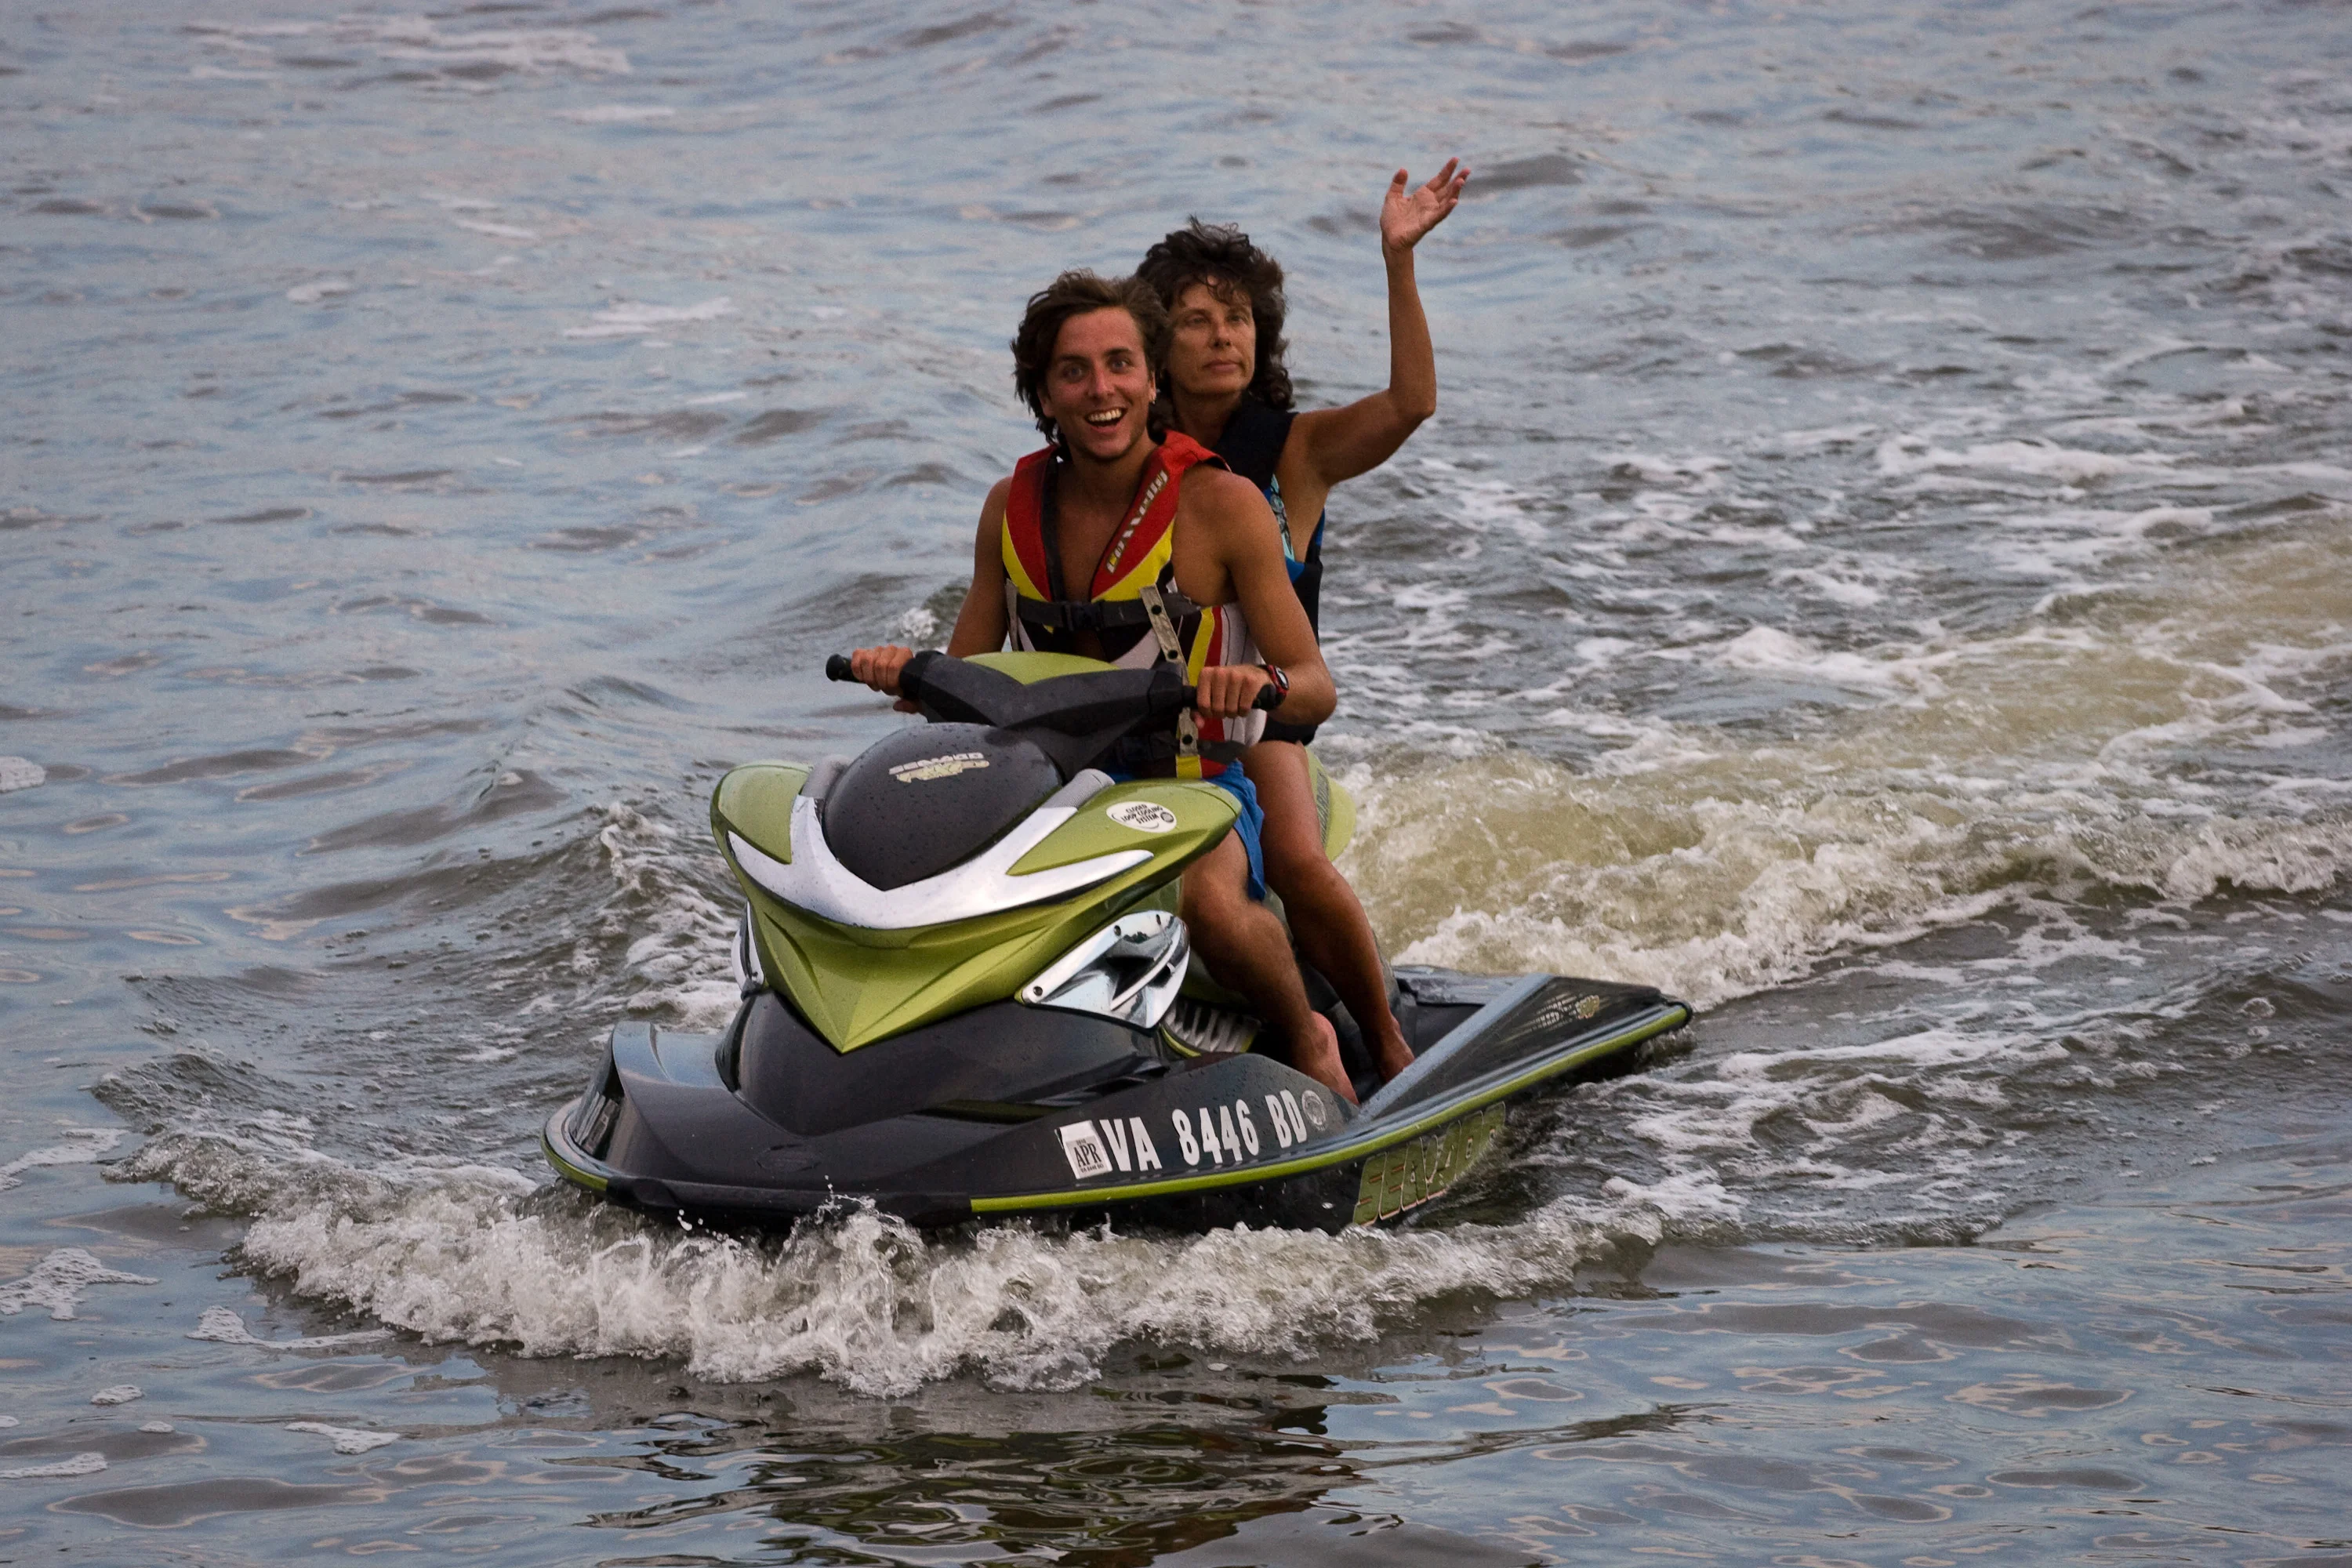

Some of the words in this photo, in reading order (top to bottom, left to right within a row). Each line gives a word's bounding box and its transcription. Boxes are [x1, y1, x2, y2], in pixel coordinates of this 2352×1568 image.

[1135, 813, 1160, 824] SYSTEM
[1137, 805, 1163, 816] COOLING
[1099, 1116, 1163, 1172] VA
[1172, 1098, 1259, 1167] 8446
[1264, 1089, 1308, 1149] BD
[1073, 1143, 1102, 1167] APR
